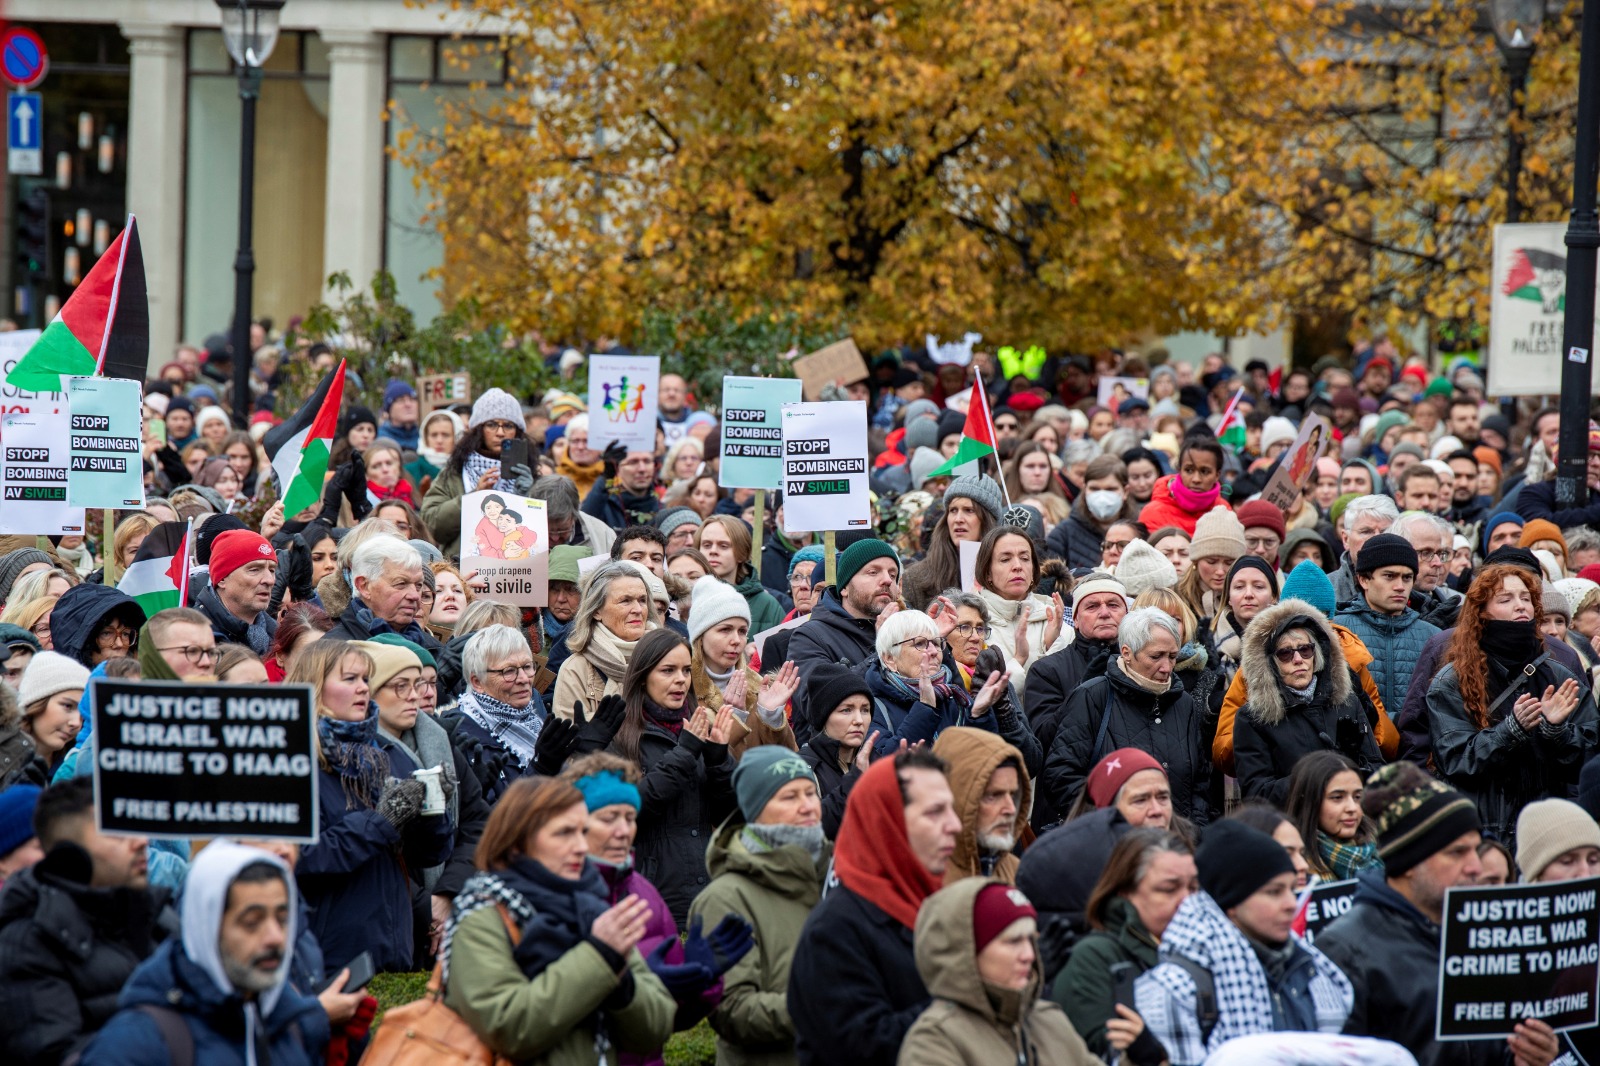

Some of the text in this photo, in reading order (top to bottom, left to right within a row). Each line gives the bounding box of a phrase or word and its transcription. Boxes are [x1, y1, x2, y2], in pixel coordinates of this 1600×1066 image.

[424, 377, 465, 401] FREE
[72, 416, 109, 428] STOPP
[726, 409, 765, 421] STOPP
[72, 436, 138, 451] BOMBINGEN
[725, 444, 781, 456] AV SIVILE!
[787, 440, 829, 453] STOPP
[7, 448, 49, 460] STOPP
[72, 458, 126, 470] AV SIVILE!
[788, 459, 864, 473] BOMBINGEN
[6, 487, 66, 499] AV SIVILE!
[788, 480, 849, 494] AV SIVILE!
[498, 566, 532, 576] drapene
[495, 578, 532, 594] sivile
[105, 693, 300, 721] JUSTICE NOW!
[121, 722, 287, 748] ISRAEL WAR
[100, 748, 310, 778] CRIME TO HAAG
[113, 798, 300, 824] FREE PALESTINE
[1322, 895, 1354, 918] NO
[1456, 890, 1596, 922] JUSTICE NOW!
[1468, 918, 1587, 949] ISRAEL WAR
[1446, 943, 1598, 976] CRIME TO HAAG
[1454, 992, 1589, 1021] FREE PALESTINE
